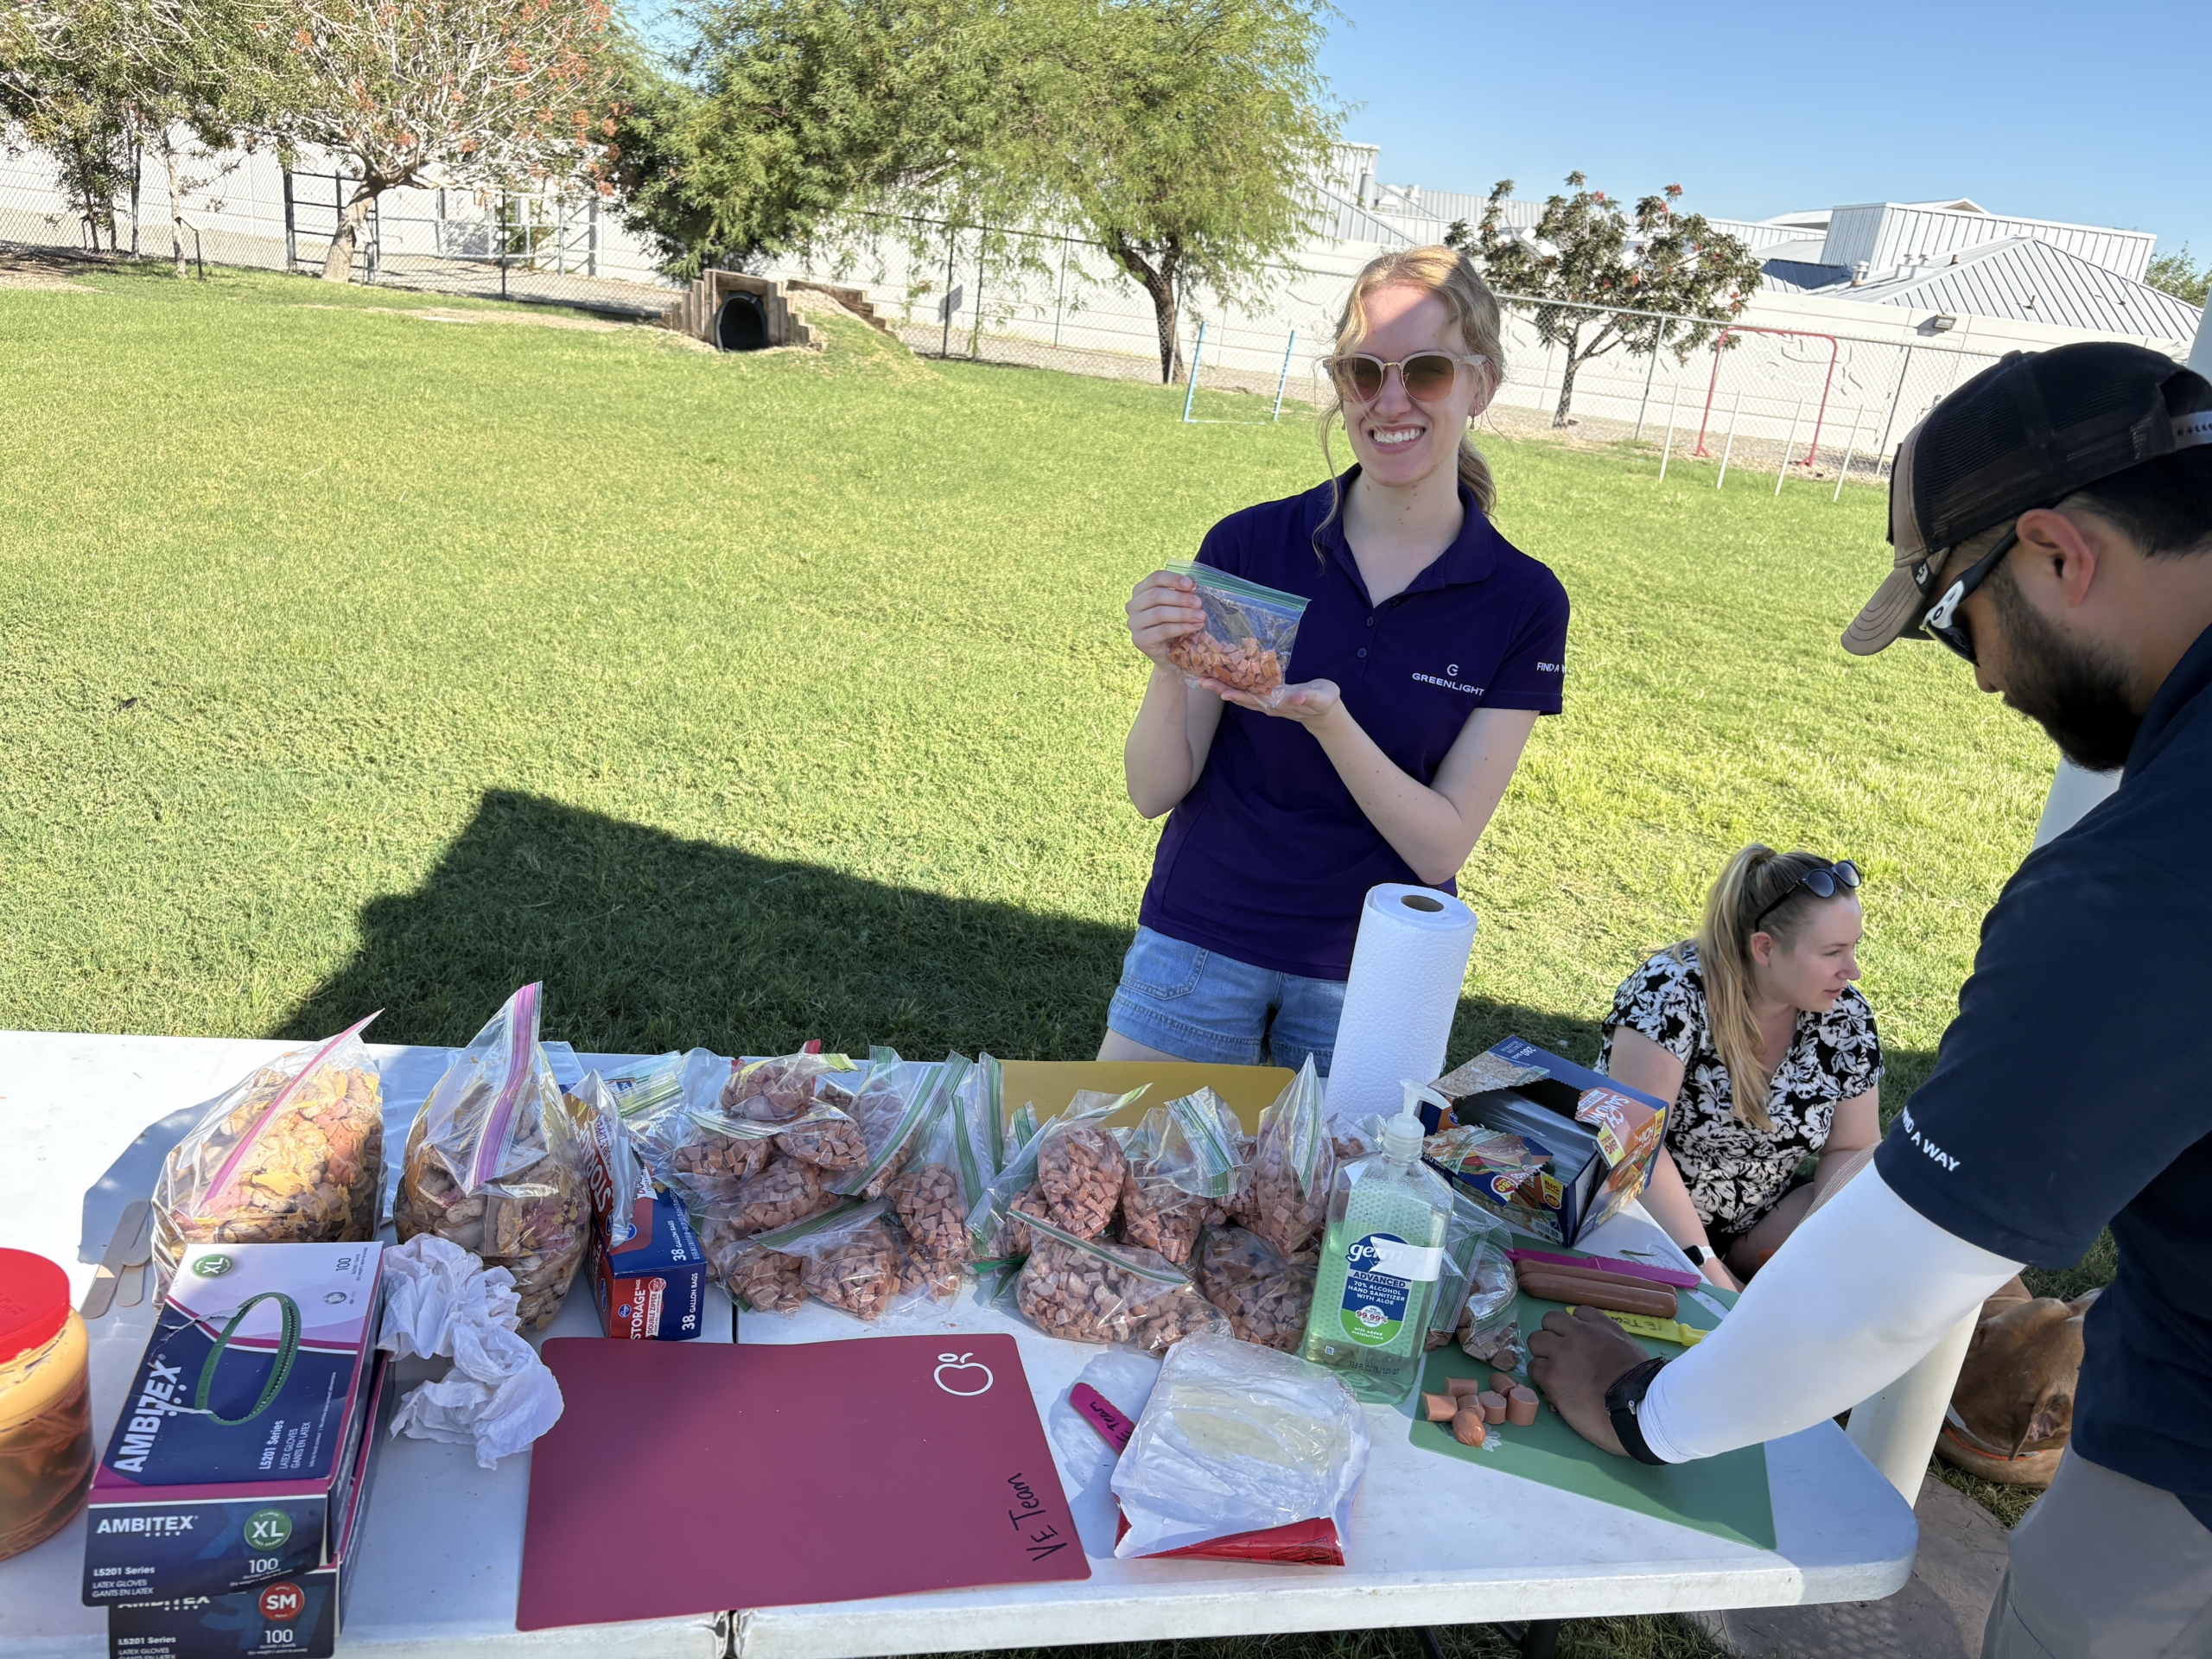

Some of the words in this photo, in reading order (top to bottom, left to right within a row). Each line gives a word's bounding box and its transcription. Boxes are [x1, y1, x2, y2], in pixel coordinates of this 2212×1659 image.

[1412, 672, 1484, 696] GREENLIGHT
[1605, 1139, 1618, 1155] BIG
[1910, 1131, 1921, 1147] A
[1923, 1138, 1961, 1172] WAY
[576, 1121, 612, 1212] STORAGE
[1544, 1179, 1560, 1192] BIG
[667, 1220, 677, 1231] BAGS
[672, 1231, 683, 1249] GALLON
[671, 1249, 687, 1262] 38
[202, 1257, 225, 1274] XL
[335, 1257, 352, 1272] 100
[1353, 1271, 1406, 1288] ADVANCED
[1348, 1285, 1370, 1294] HAND
[1370, 1290, 1406, 1303] SANITIZER
[1357, 1293, 1375, 1301] WITH
[1369, 1284, 1402, 1296] ALCOHOL
[630, 1289, 645, 1340] STORAGE
[681, 1314, 696, 1331] 38
[1356, 1311, 1389, 1324] 99.99%
[113, 1359, 182, 1473] AMBITEX
[266, 1420, 285, 1445] Series
[301, 1421, 312, 1439] LATEX
[283, 1428, 299, 1452] GLOVES
[298, 1439, 307, 1448] EN
[278, 1452, 291, 1470] LATEX
[290, 1448, 304, 1469] GANTS
[1007, 1472, 1046, 1531] Team
[96, 1515, 194, 1534] AMBITEX
[251, 1521, 285, 1538] XL
[124, 1566, 156, 1575] Series
[249, 1557, 279, 1573] 100
[116, 1579, 148, 1588] GLOVES
[120, 1588, 130, 1597] EN
[131, 1587, 154, 1597] LATEX
[265, 1593, 297, 1611] SM
[147, 1636, 176, 1644] Series
[264, 1629, 294, 1643] 100
